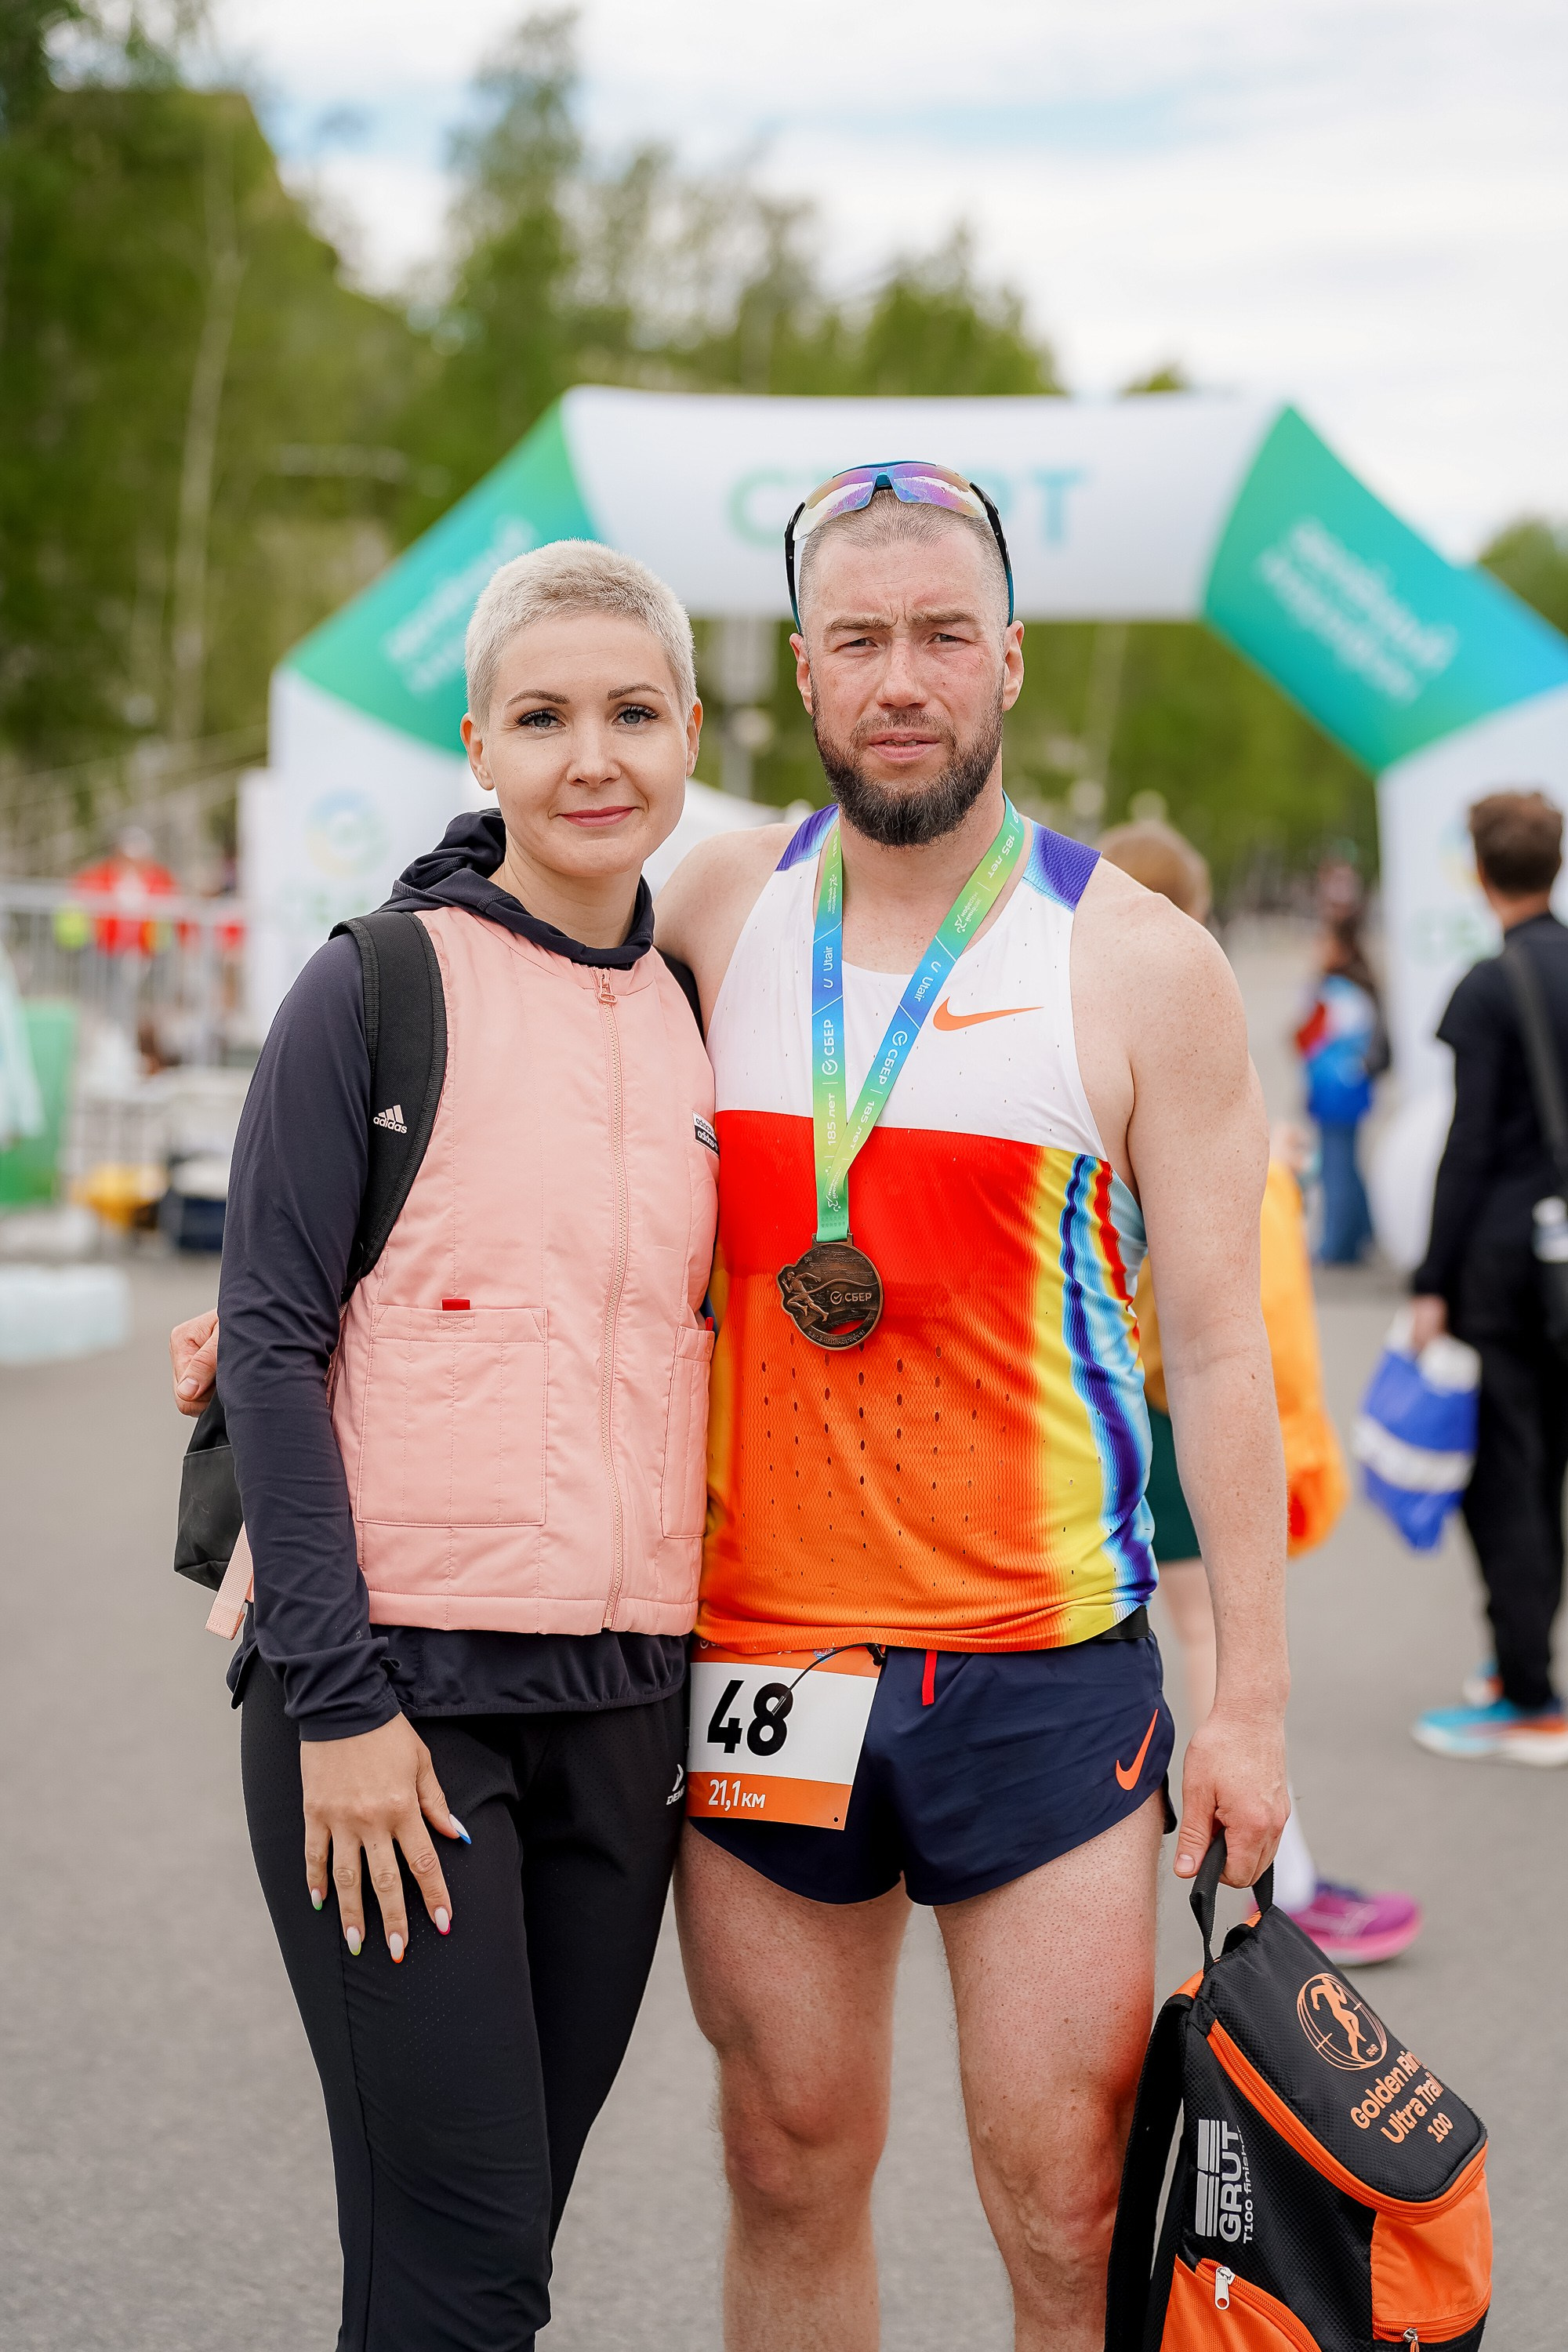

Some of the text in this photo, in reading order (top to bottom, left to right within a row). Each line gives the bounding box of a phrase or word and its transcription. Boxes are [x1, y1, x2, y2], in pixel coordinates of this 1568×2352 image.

[728, 466, 1085, 546] СРТ
[987, 835, 1015, 879] 185 лет
[822, 946, 833, 972] Utair
[914, 977, 934, 1003] Utair
[824, 1019, 835, 1056] СБЕР
[879, 1048, 898, 1085] СБЕР
[373, 1116, 408, 1134] adidas
[827, 1121, 837, 1146] 185
[850, 1101, 875, 1150] 185 лет
[844, 1292, 873, 1302] СБЕР
[706, 1679, 793, 1757] 48
[1350, 2067, 1410, 2129] Golden
[1380, 2097, 1428, 2144] Ultra
[1427, 2112, 1454, 2143] 100
[1219, 2120, 1243, 2242] GRUT
[1243, 2199, 1254, 2245] T100
